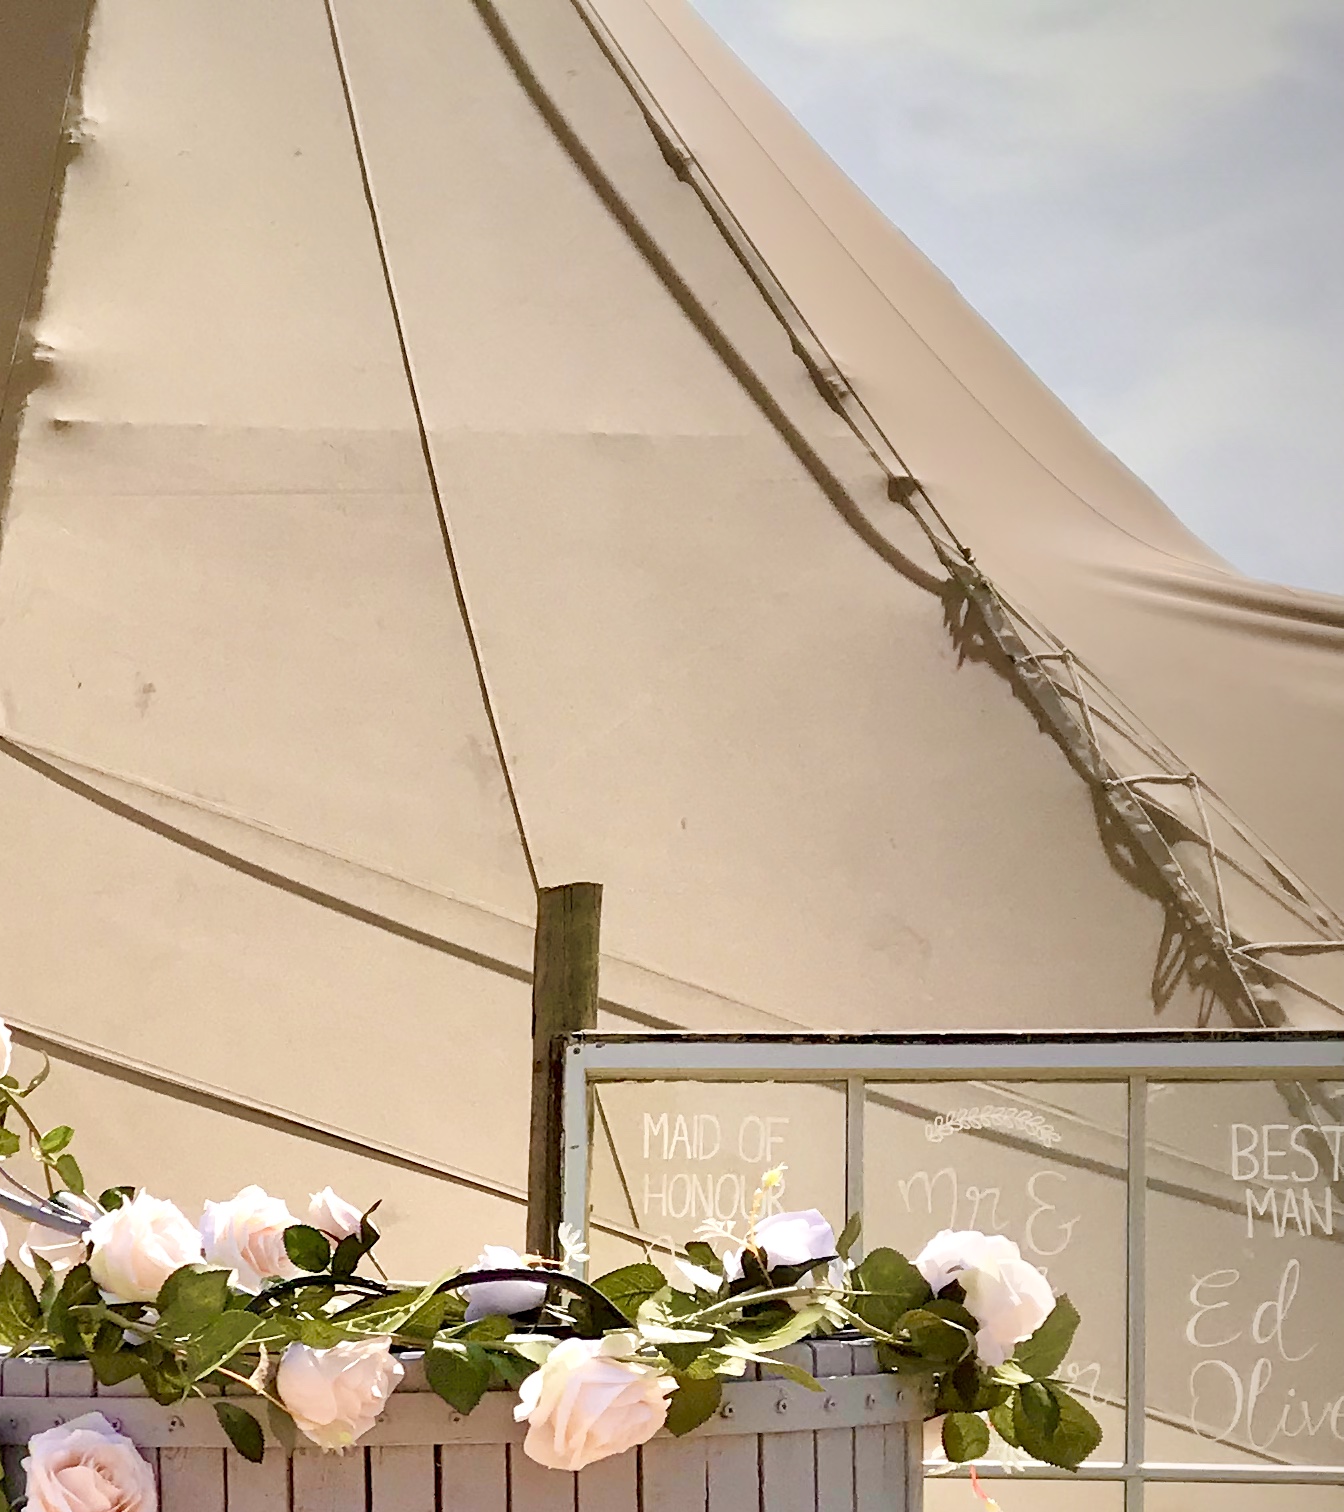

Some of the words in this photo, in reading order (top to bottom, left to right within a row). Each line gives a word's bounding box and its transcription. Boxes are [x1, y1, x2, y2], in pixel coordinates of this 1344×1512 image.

[643, 1112, 721, 1160] MAID
[739, 1115, 789, 1163] OF
[1231, 1123, 1344, 1182] BEST
[644, 1173, 786, 1220] HONOUR
[898, 1168, 1009, 1230] Mr
[1025, 1170, 1081, 1255] &
[1246, 1186, 1333, 1238] MAN
[1186, 1258, 1319, 1361] Ed
